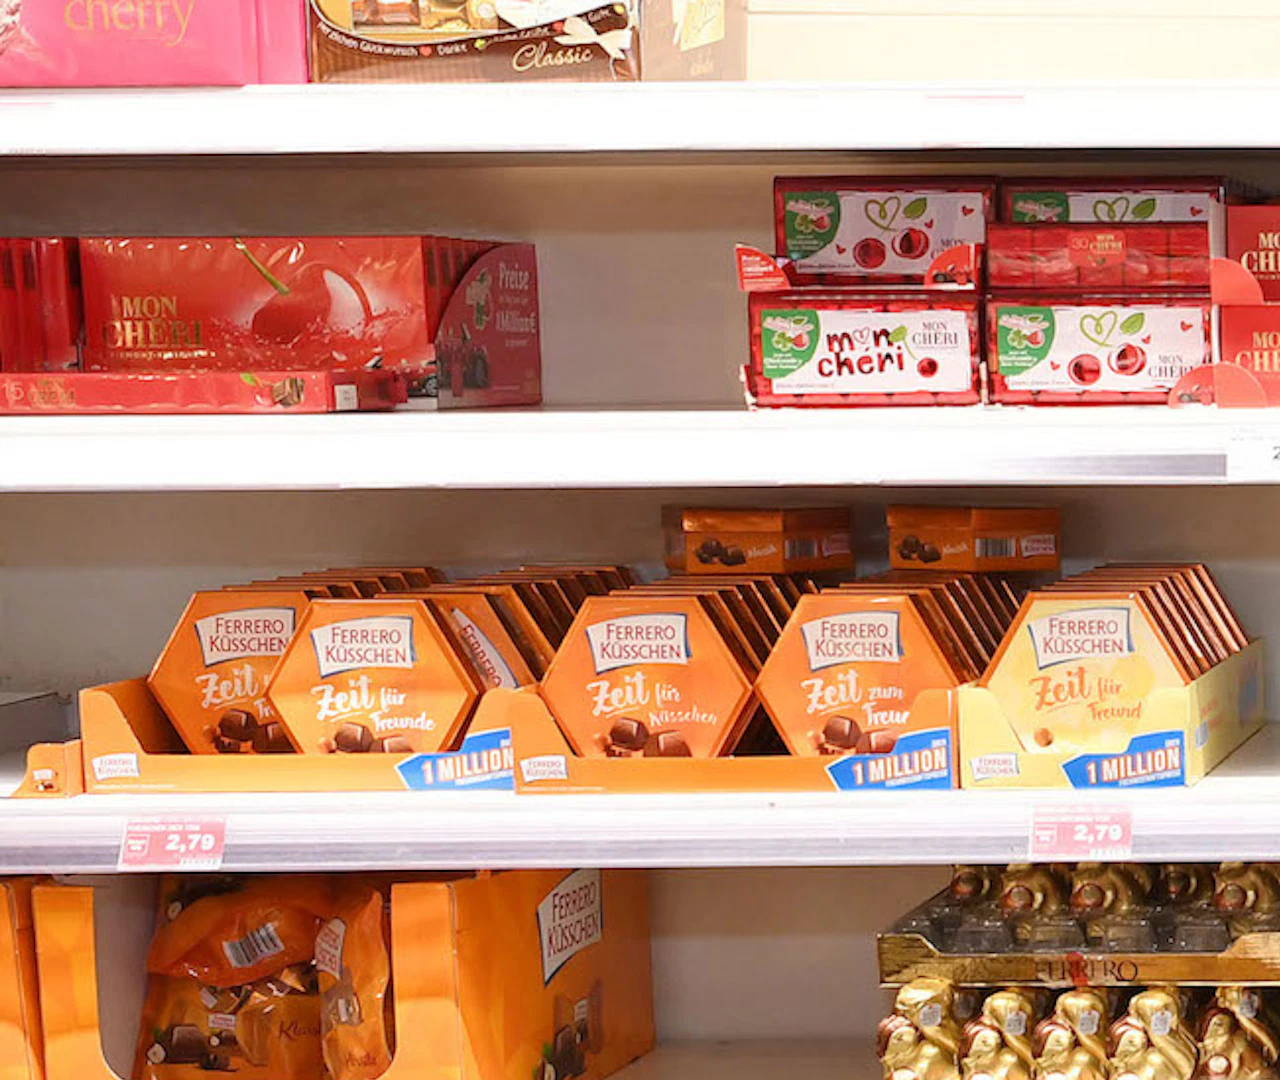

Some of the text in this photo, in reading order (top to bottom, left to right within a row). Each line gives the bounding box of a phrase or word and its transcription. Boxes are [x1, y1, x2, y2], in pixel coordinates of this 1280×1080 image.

[64, 0, 194, 44] cherry
[512, 41, 593, 72] Classic
[122, 296, 178, 319] MON
[818, 344, 905, 377] chéri
[215, 618, 285, 636] FERRERO
[605, 623, 676, 641] FERRERO
[820, 620, 889, 639] FERRERO
[1047, 617, 1119, 637] FERRERO
[209, 634, 290, 654] KÜSSCHEN
[600, 640, 682, 660] KÜSSCHEN
[815, 637, 894, 659] KÜSSCHEN
[1042, 636, 1124, 656] KÜSSCHEN
[311, 674, 407, 721] Zeit für
[586, 670, 681, 717] Zeit für
[801, 669, 904, 716] Zeit zum
[1028, 666, 1123, 712] Zeit für
[370, 710, 436, 733] Freunde
[421, 745, 515, 785] 1 MILLION
[852, 761, 864, 785] 1
[867, 748, 948, 784] MILLION
[1086, 761, 1098, 785] 1
[1100, 745, 1182, 783] MILLION
[164, 833, 216, 855] 2,79
[1072, 823, 1122, 843] 2,79
